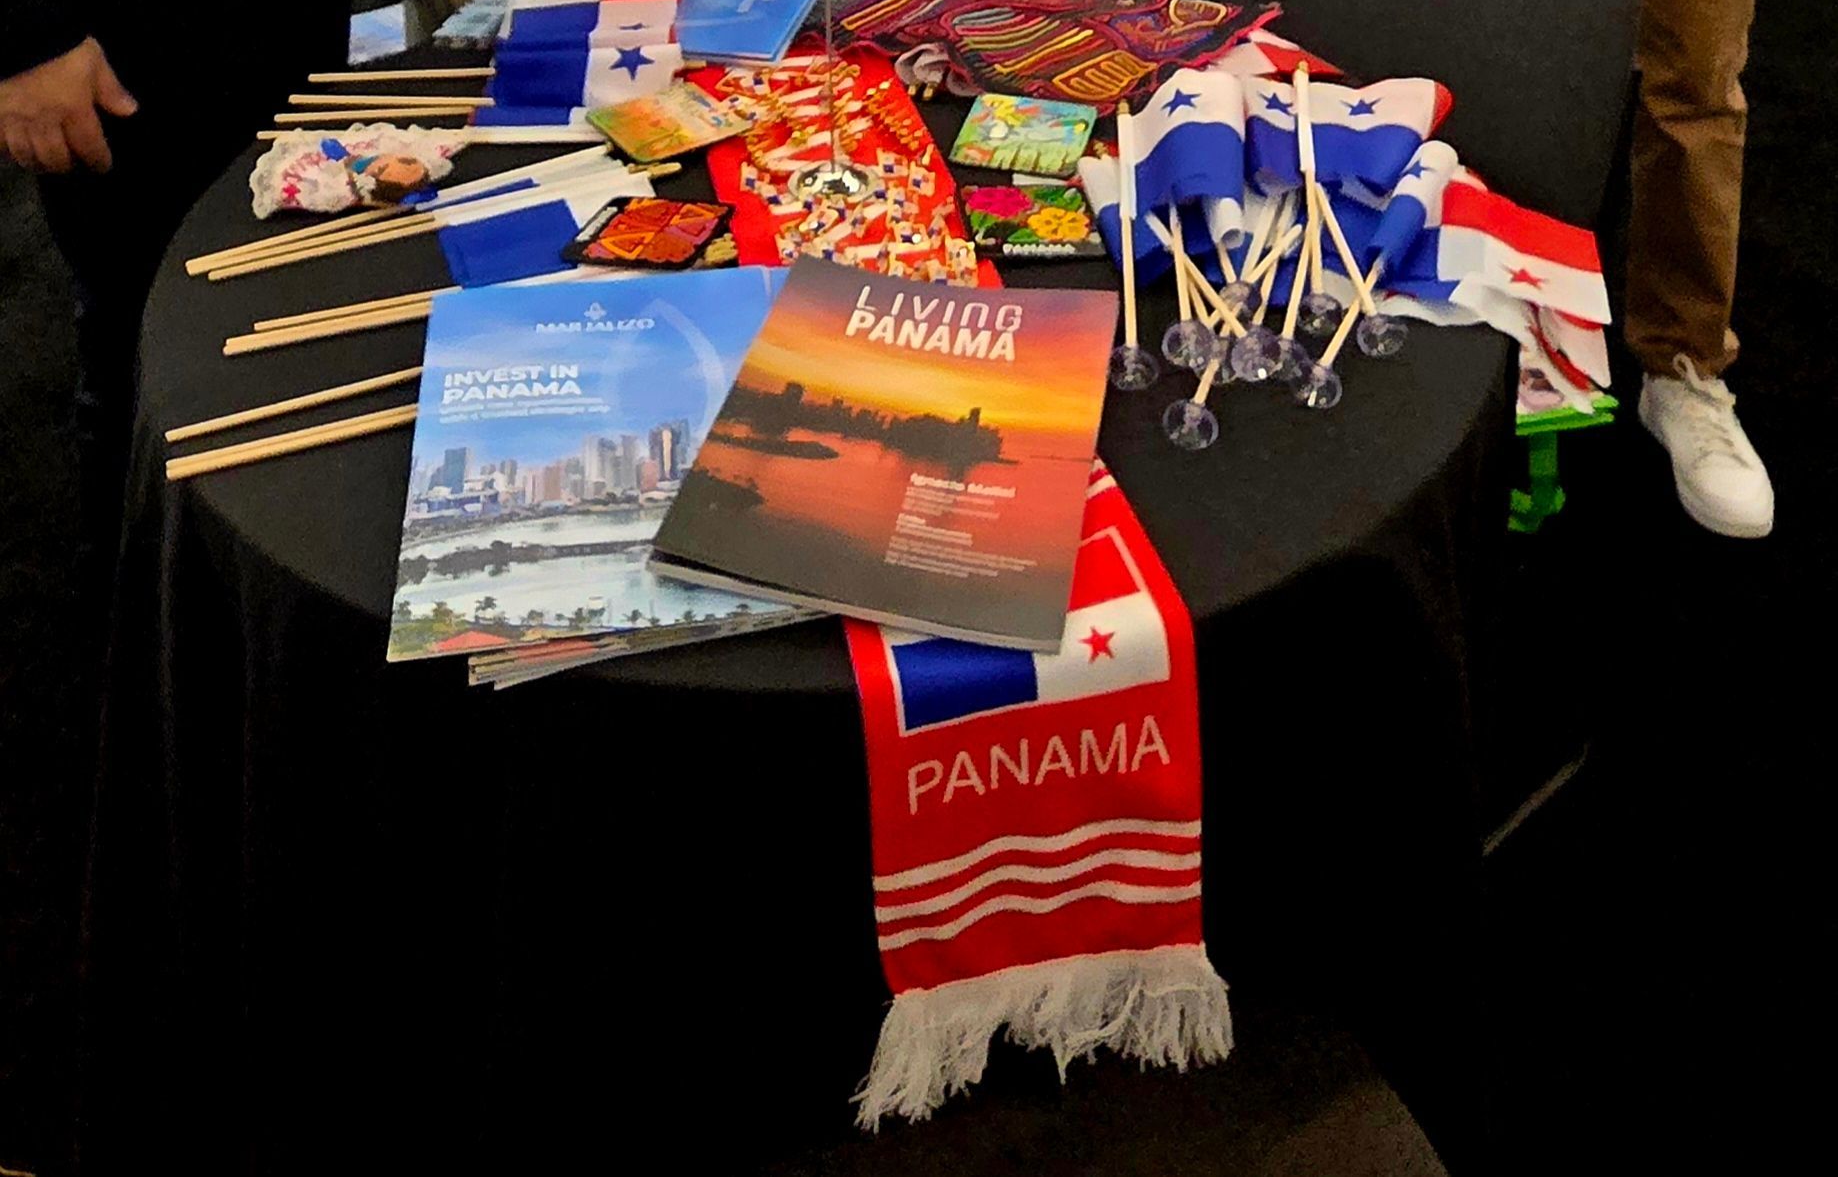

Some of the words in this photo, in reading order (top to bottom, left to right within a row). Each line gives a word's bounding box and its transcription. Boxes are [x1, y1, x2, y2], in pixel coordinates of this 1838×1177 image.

[856, 285, 1023, 333] LIVING
[442, 380, 581, 404] PANAMA
[444, 365, 544, 388] INVEST
[551, 364, 578, 379] IN
[908, 714, 1170, 816] PANAMA
